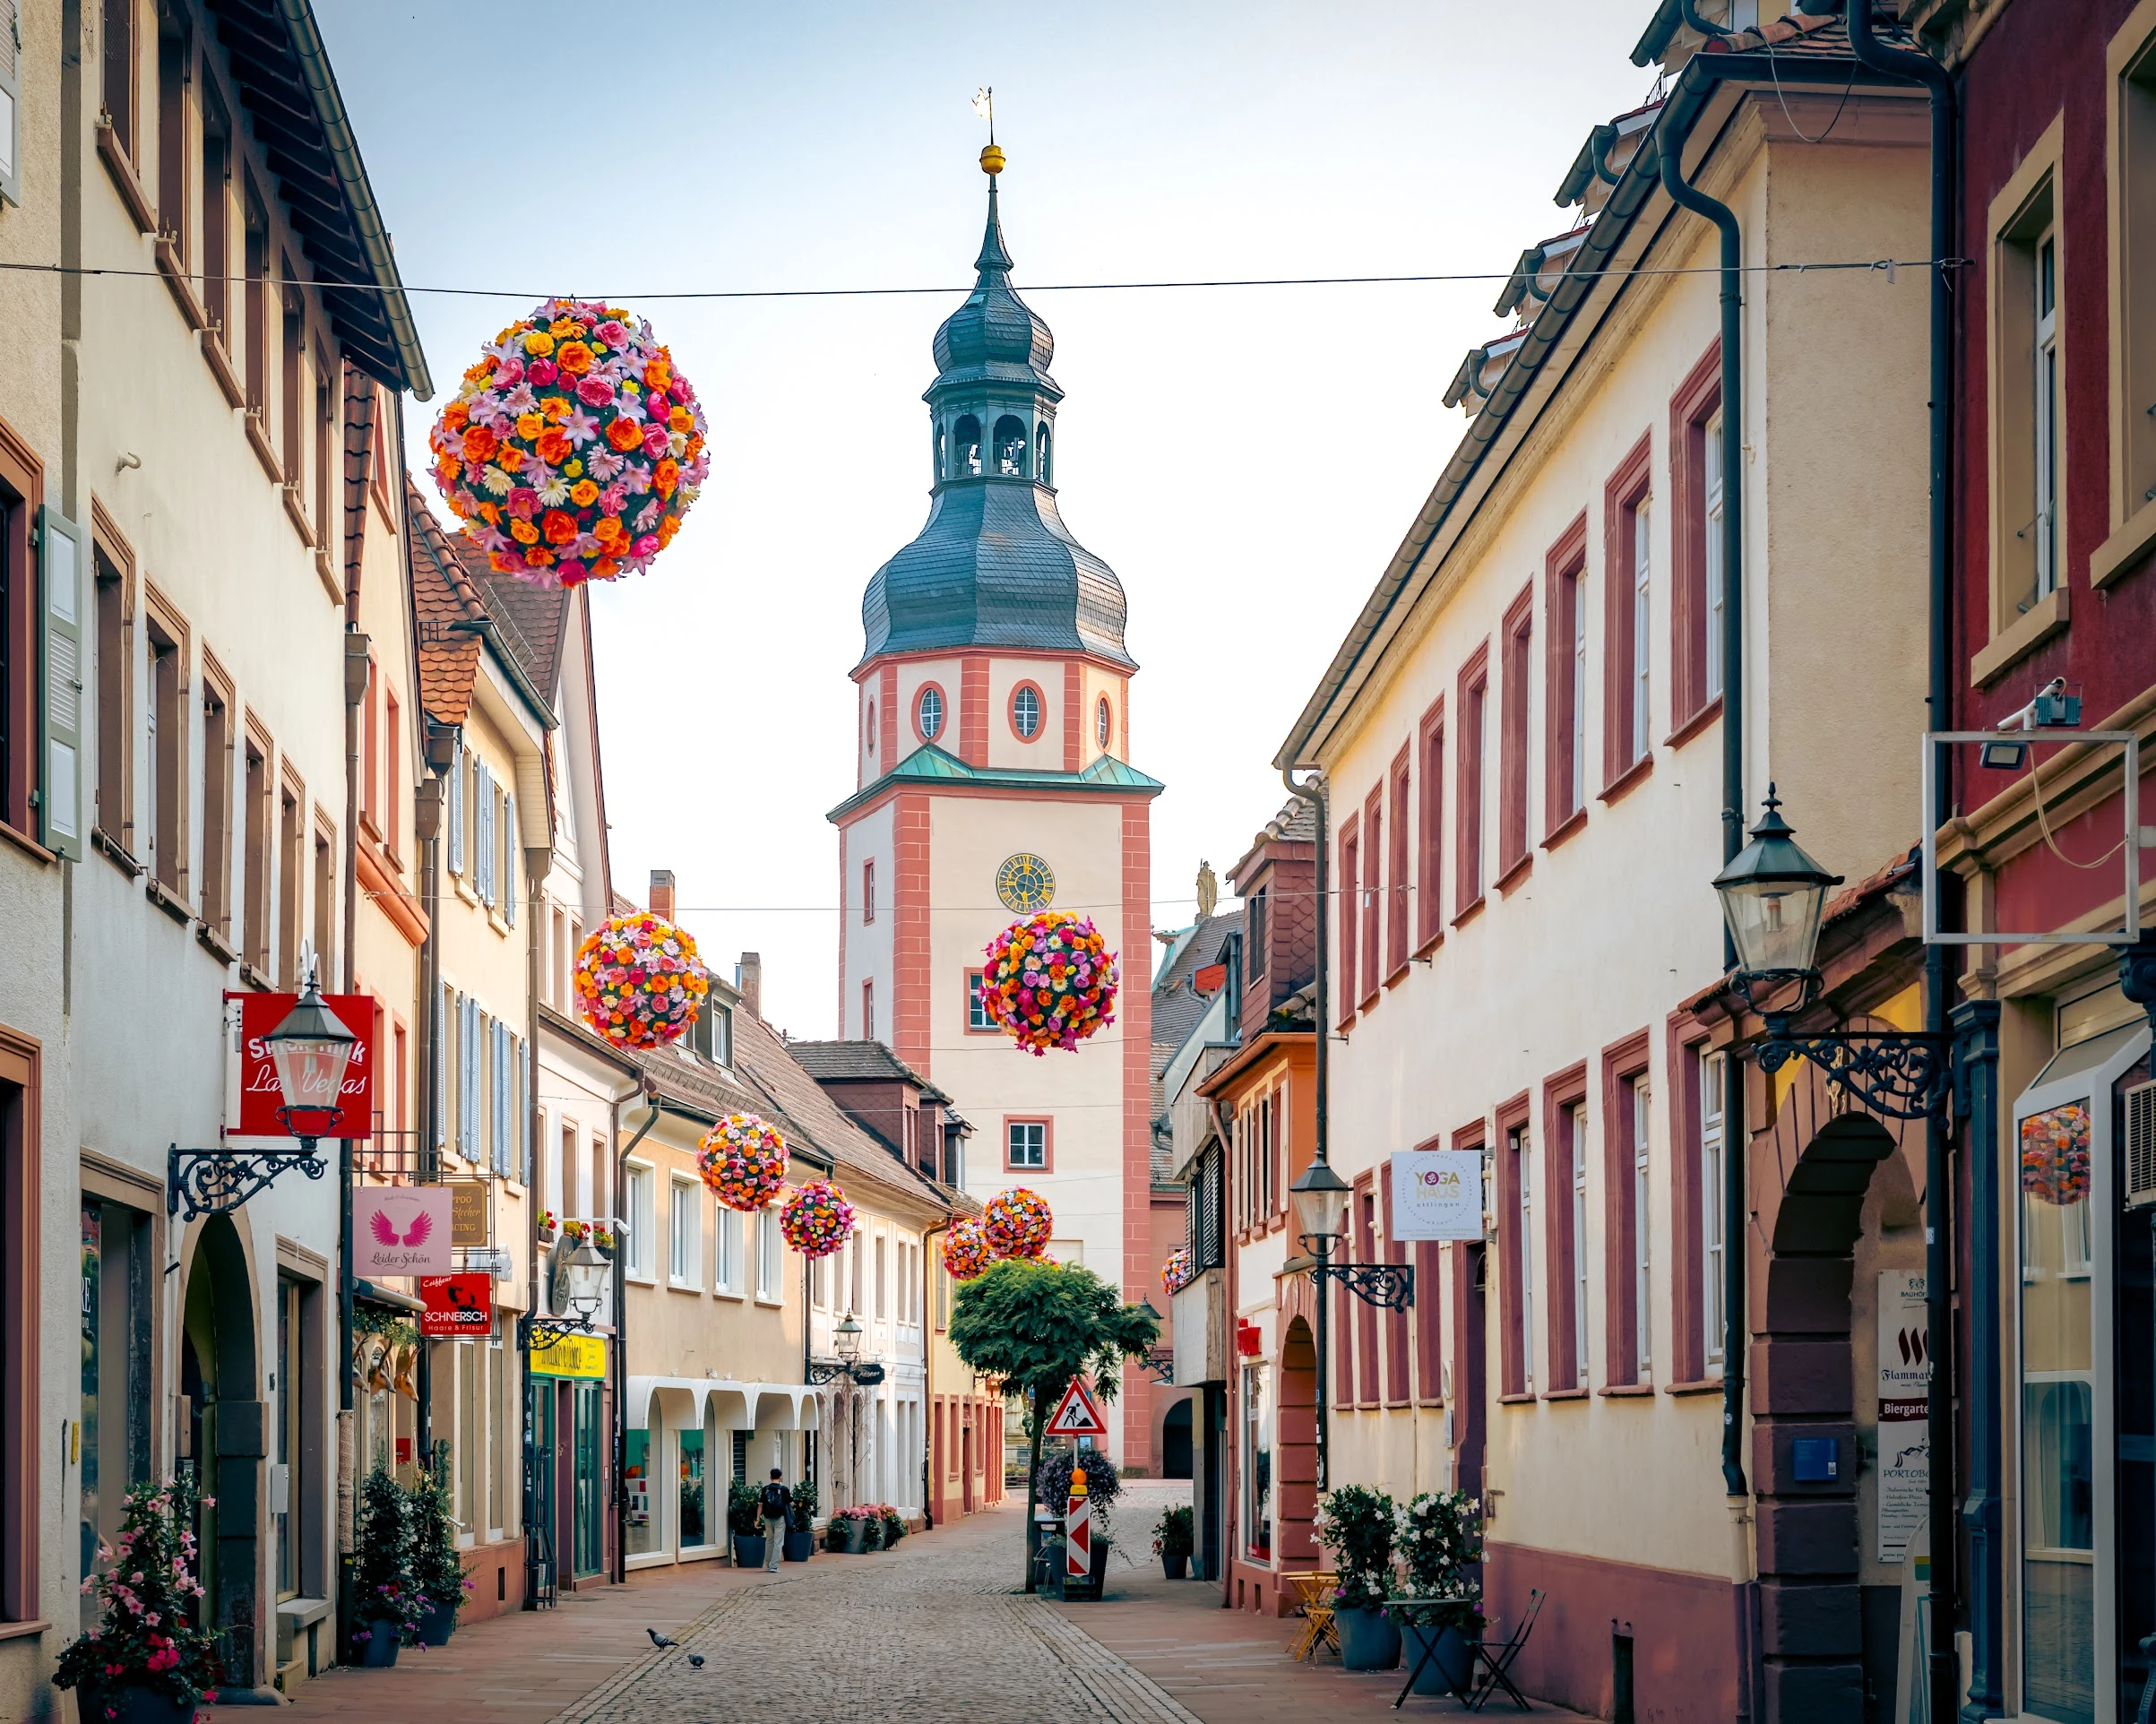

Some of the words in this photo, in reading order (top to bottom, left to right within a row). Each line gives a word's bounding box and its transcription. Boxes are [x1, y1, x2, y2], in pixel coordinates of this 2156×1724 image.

[1414, 1171, 1461, 1185] YOGA
[1416, 1185, 1460, 1200] HAUS
[370, 1252, 400, 1265] Leider
[400, 1252, 430, 1269] Schön
[423, 1276, 453, 1288] Coiffeur
[424, 1311, 487, 1322] SCHNERSCH
